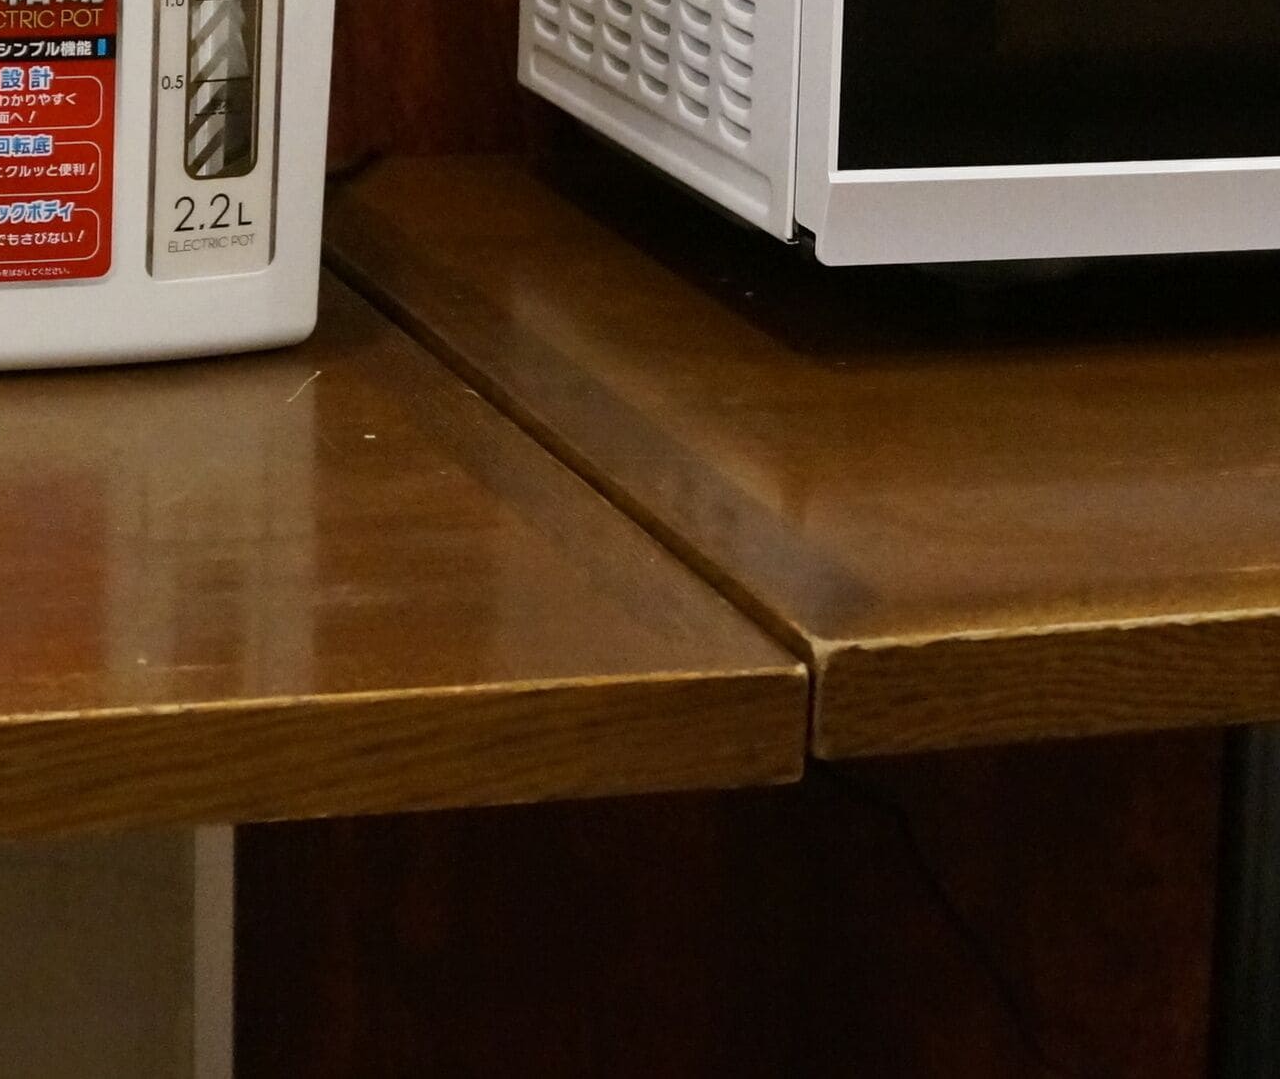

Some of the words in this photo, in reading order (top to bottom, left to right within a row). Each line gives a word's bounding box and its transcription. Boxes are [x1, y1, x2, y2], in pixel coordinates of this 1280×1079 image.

[60, 8, 105, 27] POT
[161, 75, 184, 90] 0.5
[167, 236, 228, 253] ELECTRIC
[231, 233, 255, 247] POT
